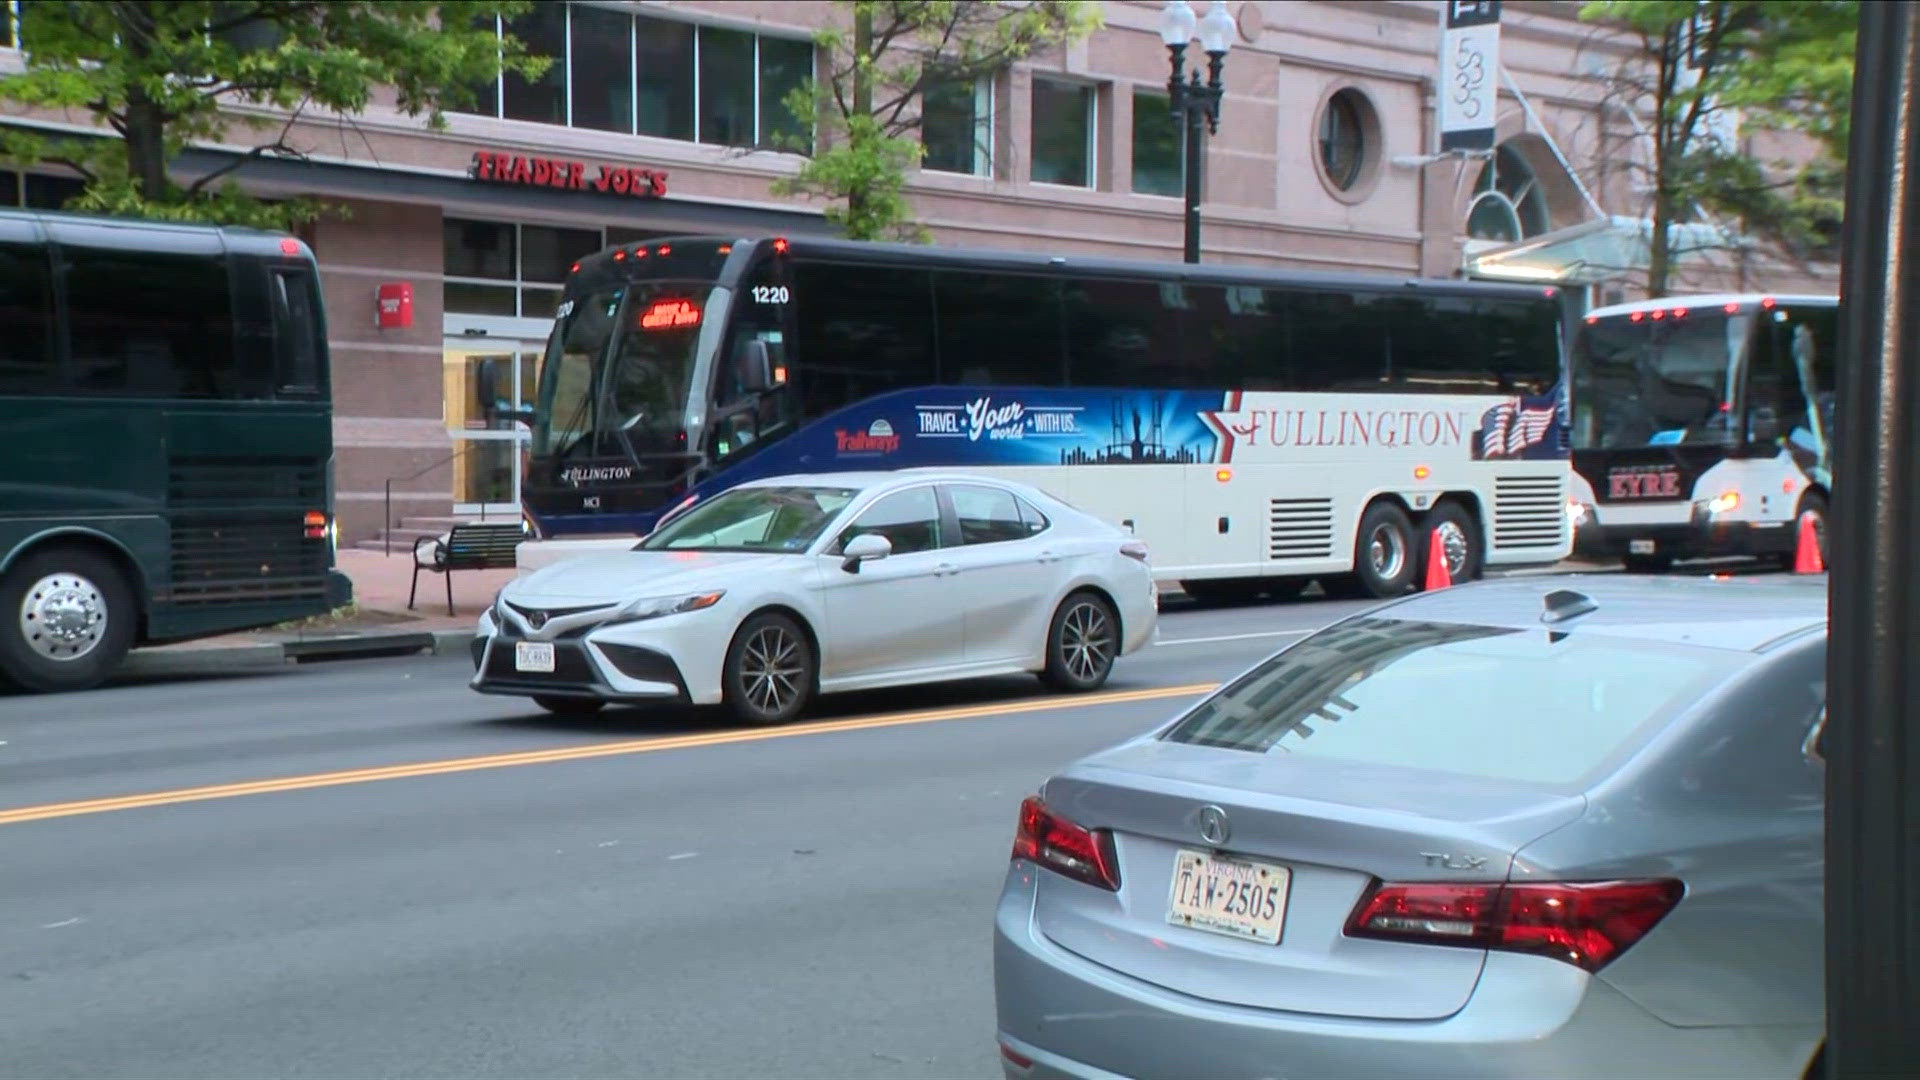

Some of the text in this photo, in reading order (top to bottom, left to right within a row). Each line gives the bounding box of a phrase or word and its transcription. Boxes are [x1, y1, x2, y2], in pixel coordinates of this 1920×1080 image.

[475, 151, 669, 197] TRADER JOE'S
[752, 286, 790, 304] 1220
[918, 412, 960, 433] TRAVEL
[965, 396, 1025, 442] Your
[1033, 413, 1060, 433] WITH
[1240, 408, 1468, 449] FULLINGTON
[989, 422, 1025, 440] world
[835, 429, 900, 455] Trailways
[561, 466, 632, 481] FULLINGTON
[1607, 472, 1681, 499] EYRE
[583, 496, 600, 509] MCI
[1420, 851, 1488, 872] TLX
[1179, 871, 1279, 920] TAW-2505
